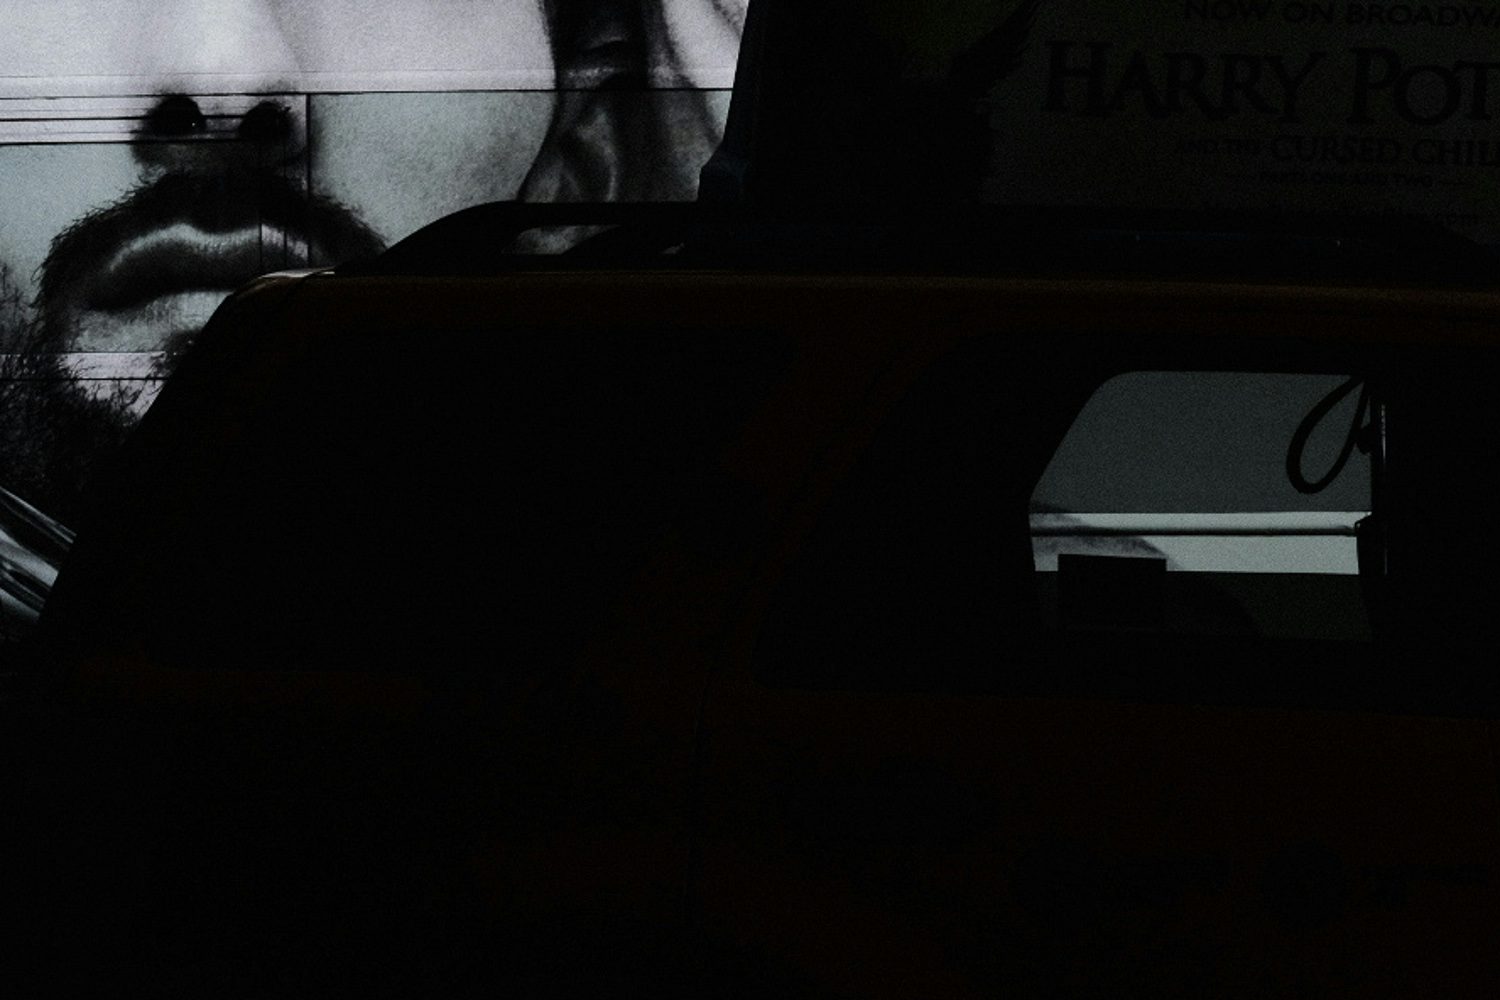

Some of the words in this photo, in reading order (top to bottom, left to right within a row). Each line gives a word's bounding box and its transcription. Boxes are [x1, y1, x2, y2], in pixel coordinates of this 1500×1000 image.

[1184, 0, 1270, 21] NOW
[1284, 3, 1334, 25] ON
[1041, 40, 1327, 122] HARRY
[1270, 134, 1402, 164] CURSED
